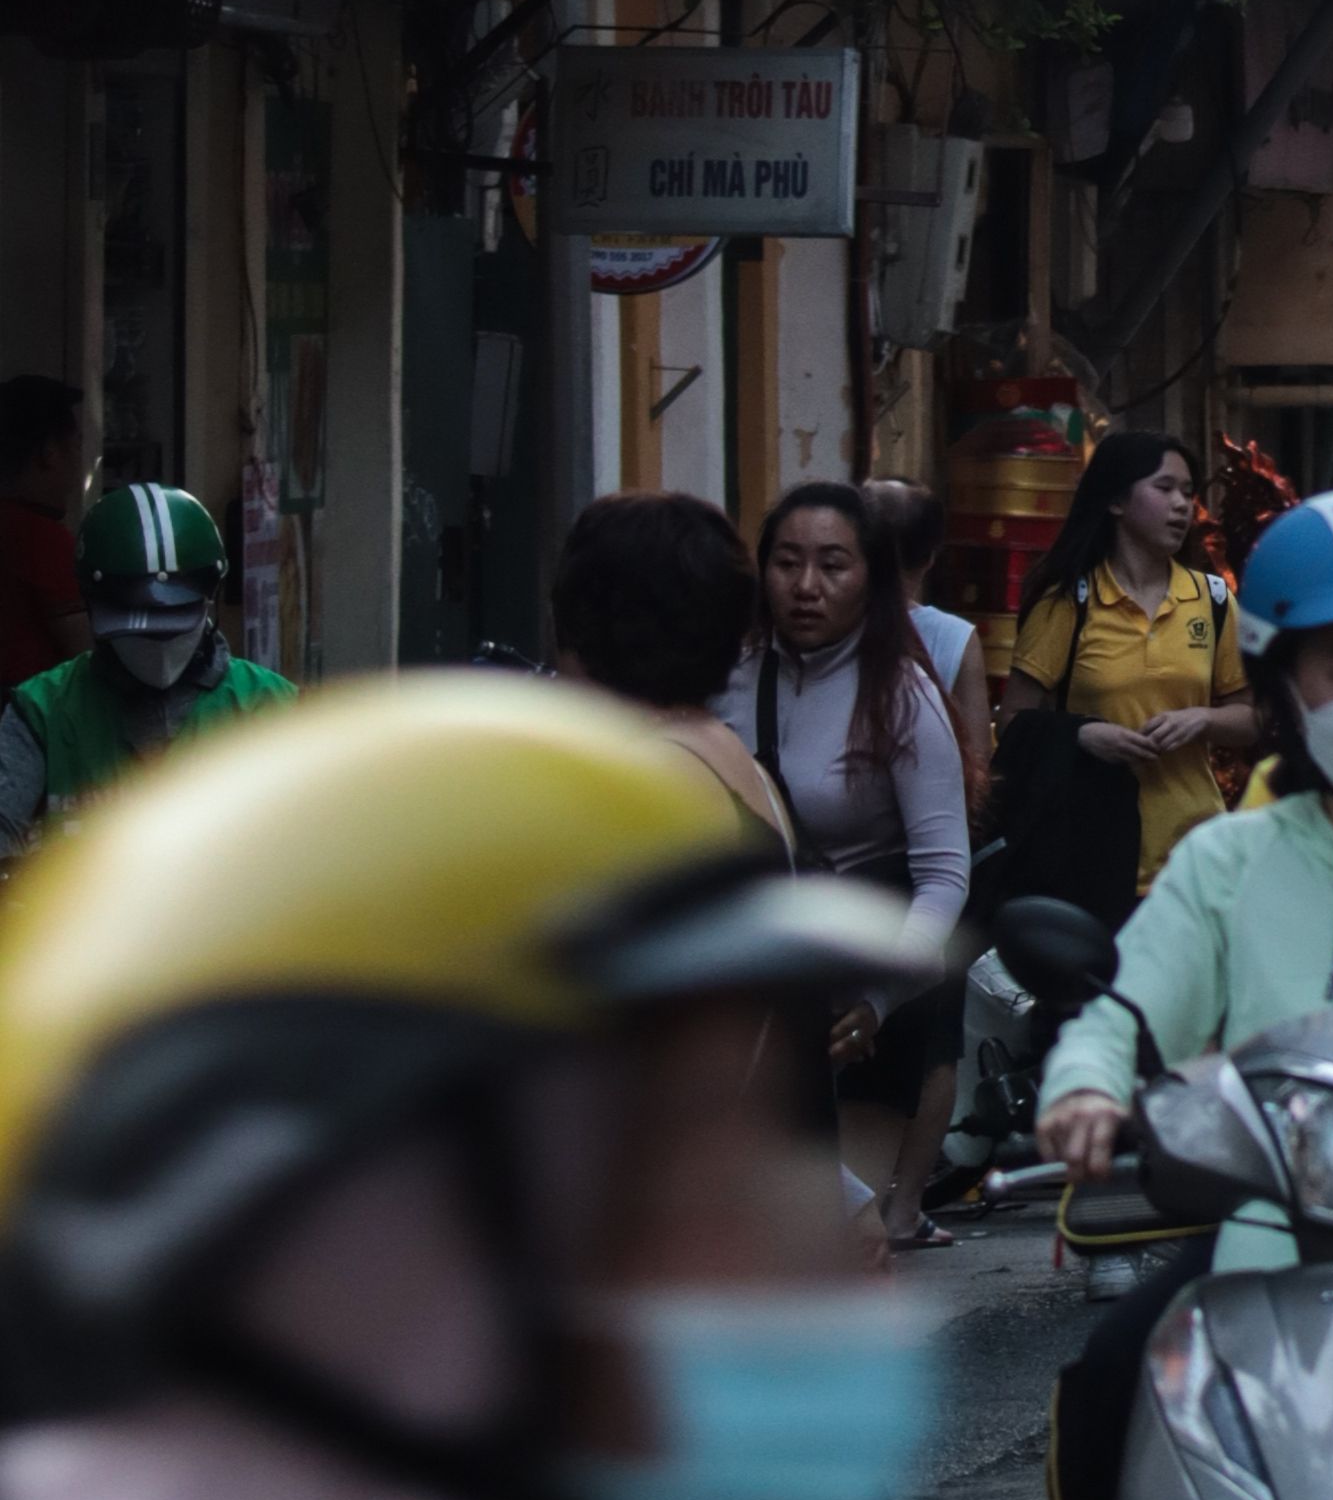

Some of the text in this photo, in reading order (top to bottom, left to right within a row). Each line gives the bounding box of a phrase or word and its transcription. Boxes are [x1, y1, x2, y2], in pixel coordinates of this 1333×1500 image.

[782, 72, 833, 119] TÀU
[649, 151, 809, 199] CHÍ MÀ PHÙ
